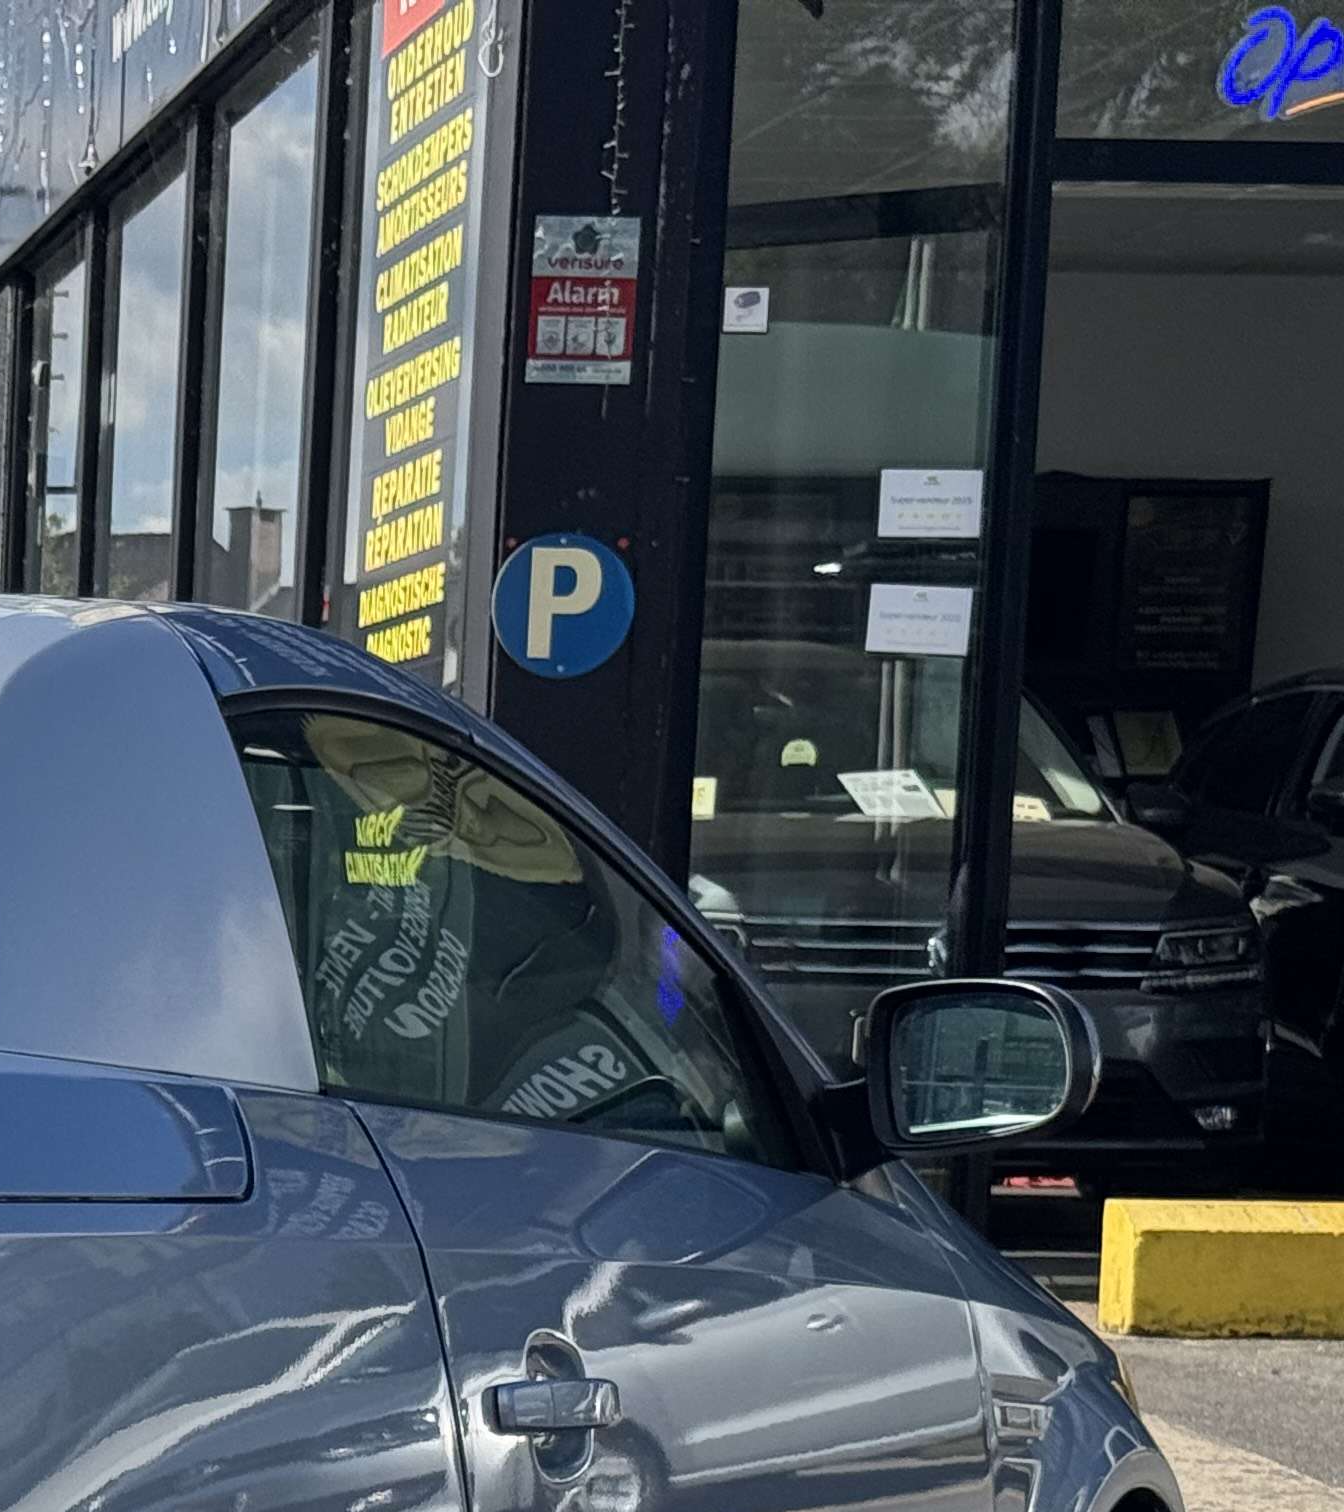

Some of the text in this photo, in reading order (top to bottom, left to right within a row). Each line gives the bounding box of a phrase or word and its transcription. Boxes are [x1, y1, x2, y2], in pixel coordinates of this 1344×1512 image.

[387, 0, 474, 100] ONDERHOUD
[390, 48, 465, 144] ENTRETIEN
[377, 107, 473, 211] SCHOKDEMPERS
[376, 160, 467, 258] AMORTISSEURS
[376, 223, 463, 314] CLIMATISATION
[546, 279, 621, 305] Alarm
[547, 254, 625, 271] verisure
[383, 281, 448, 355] RADIATEUR
[366, 336, 461, 420] OLIEVERVERSING
[385, 395, 436, 457] VIDANGE
[372, 448, 442, 519] REPARATIE
[358, 561, 446, 628] DIAGNOSTISCHE
[527, 547, 602, 659] P
